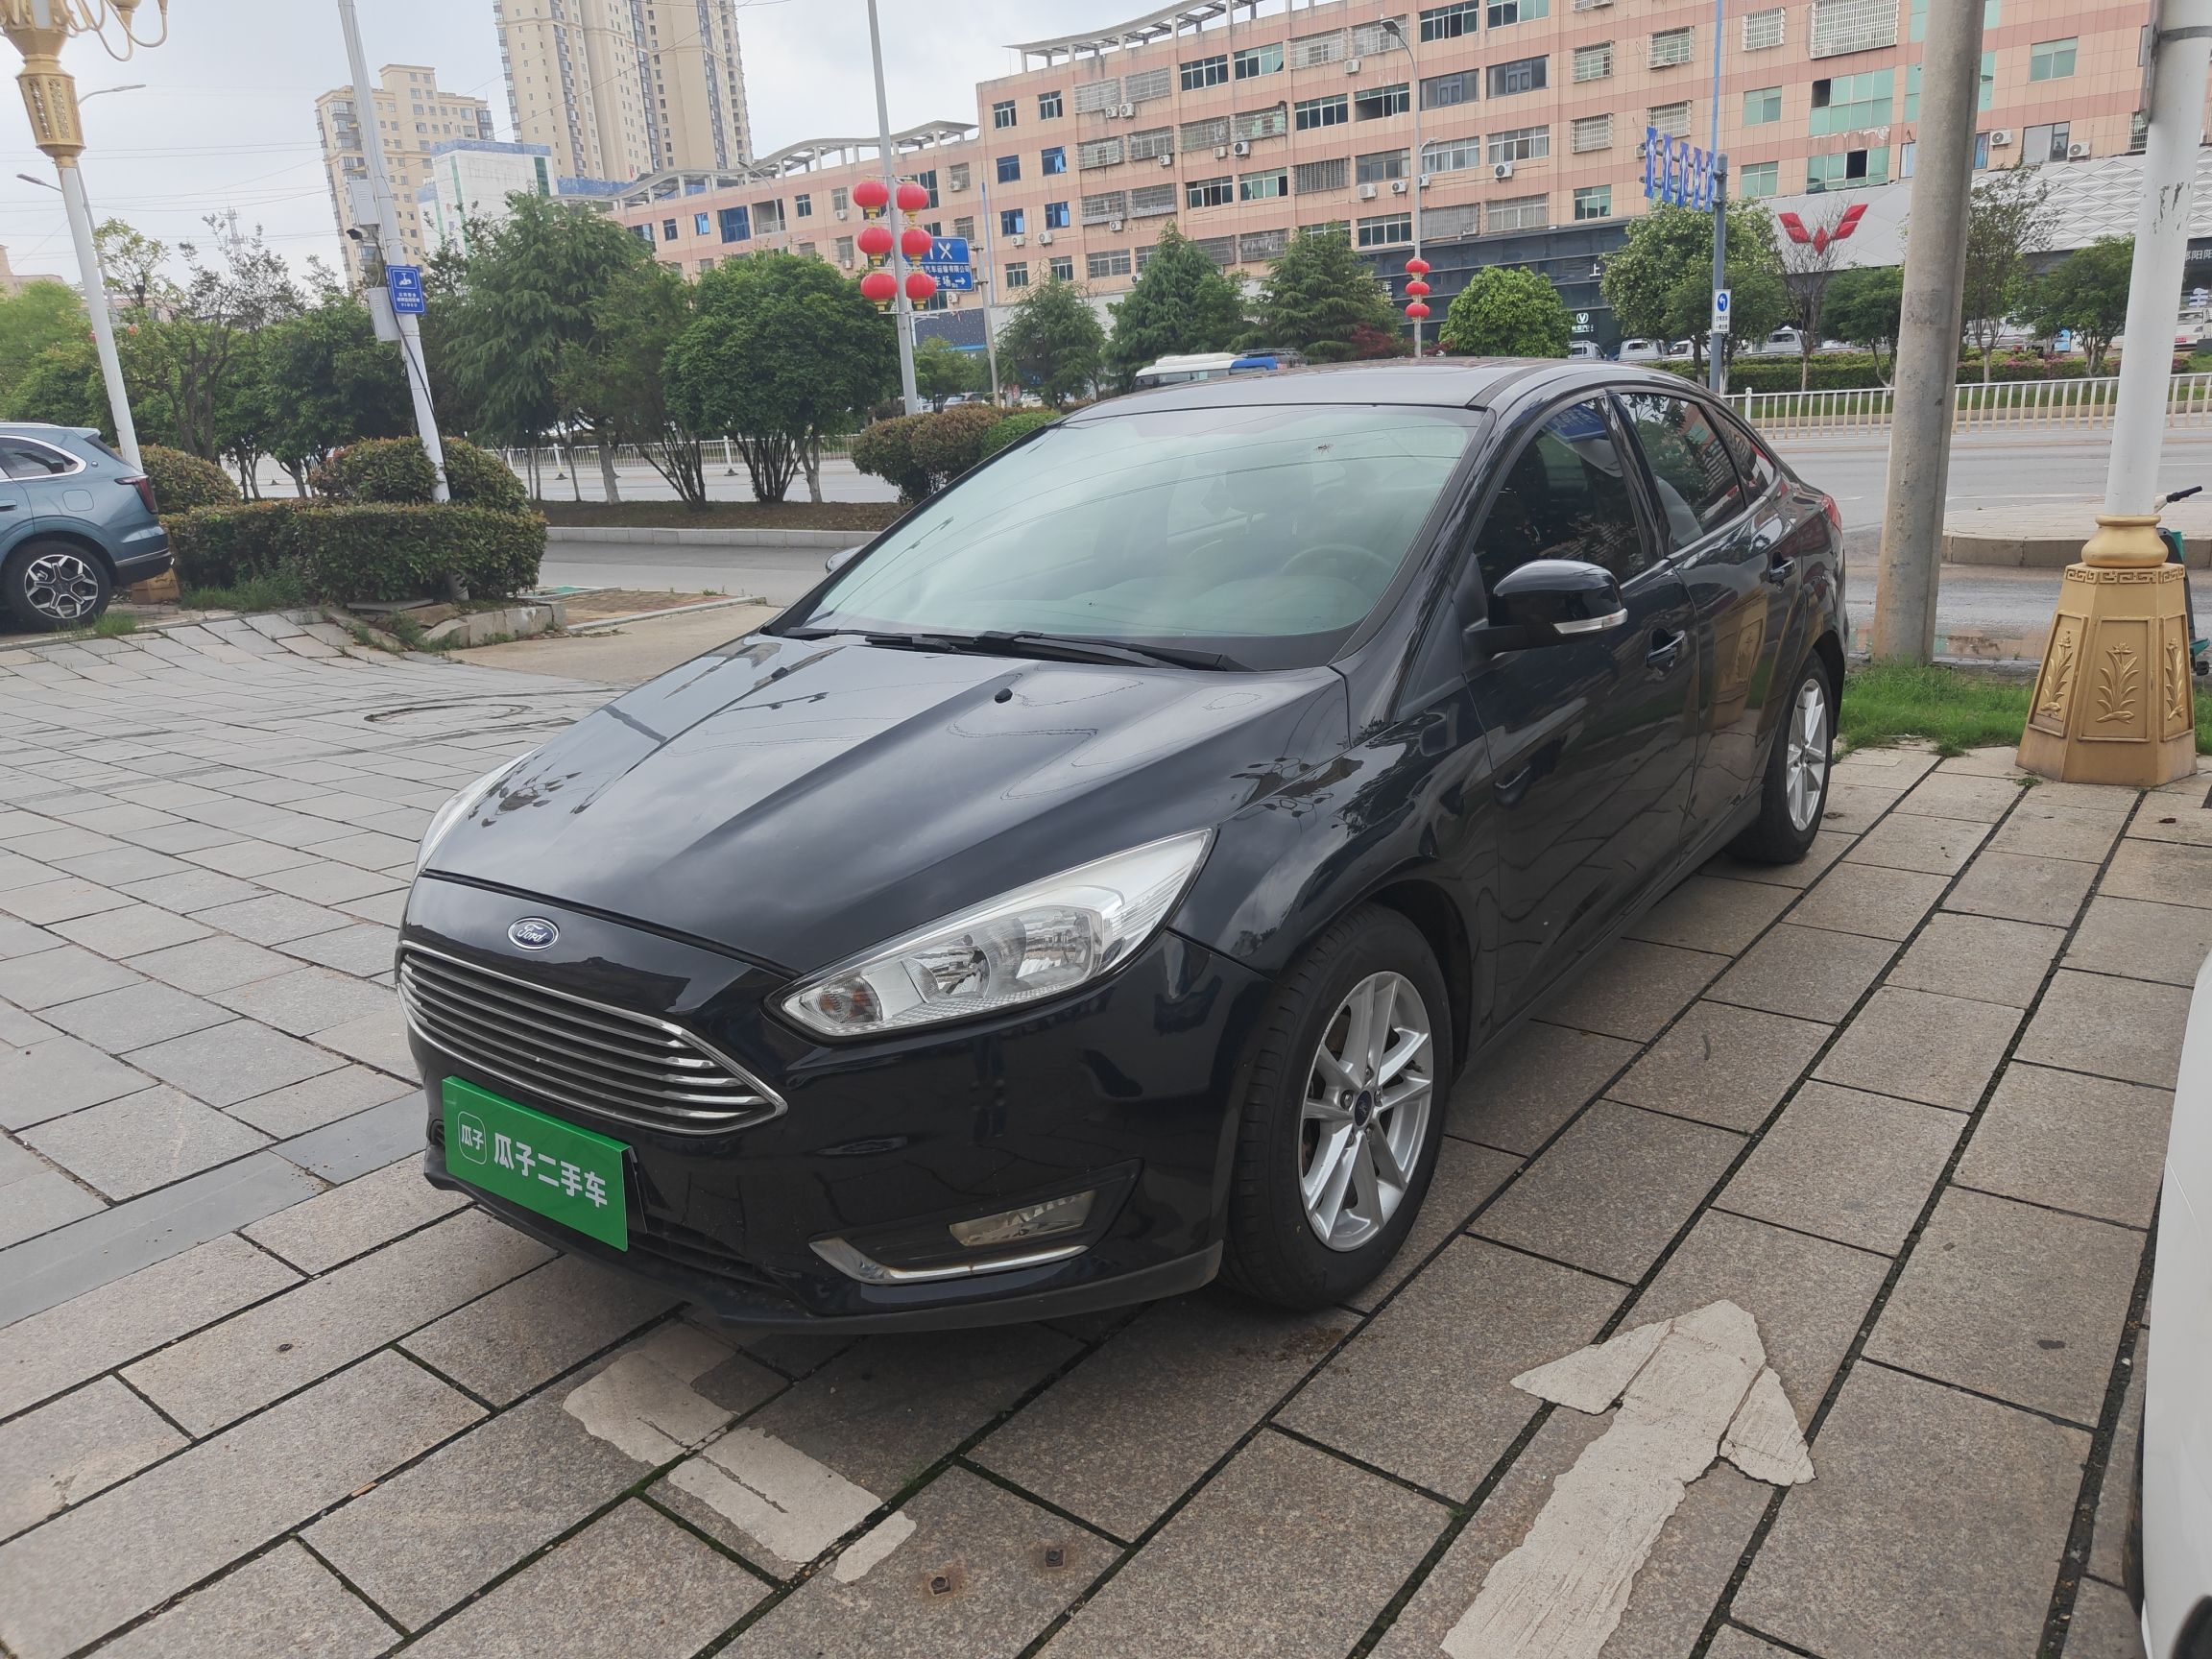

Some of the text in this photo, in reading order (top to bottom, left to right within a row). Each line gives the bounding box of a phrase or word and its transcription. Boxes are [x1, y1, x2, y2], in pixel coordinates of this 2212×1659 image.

[517, 924, 548, 943] Ford
[461, 1124, 484, 1150] 瓜子
[493, 1132, 608, 1208] 瓜子二手车
